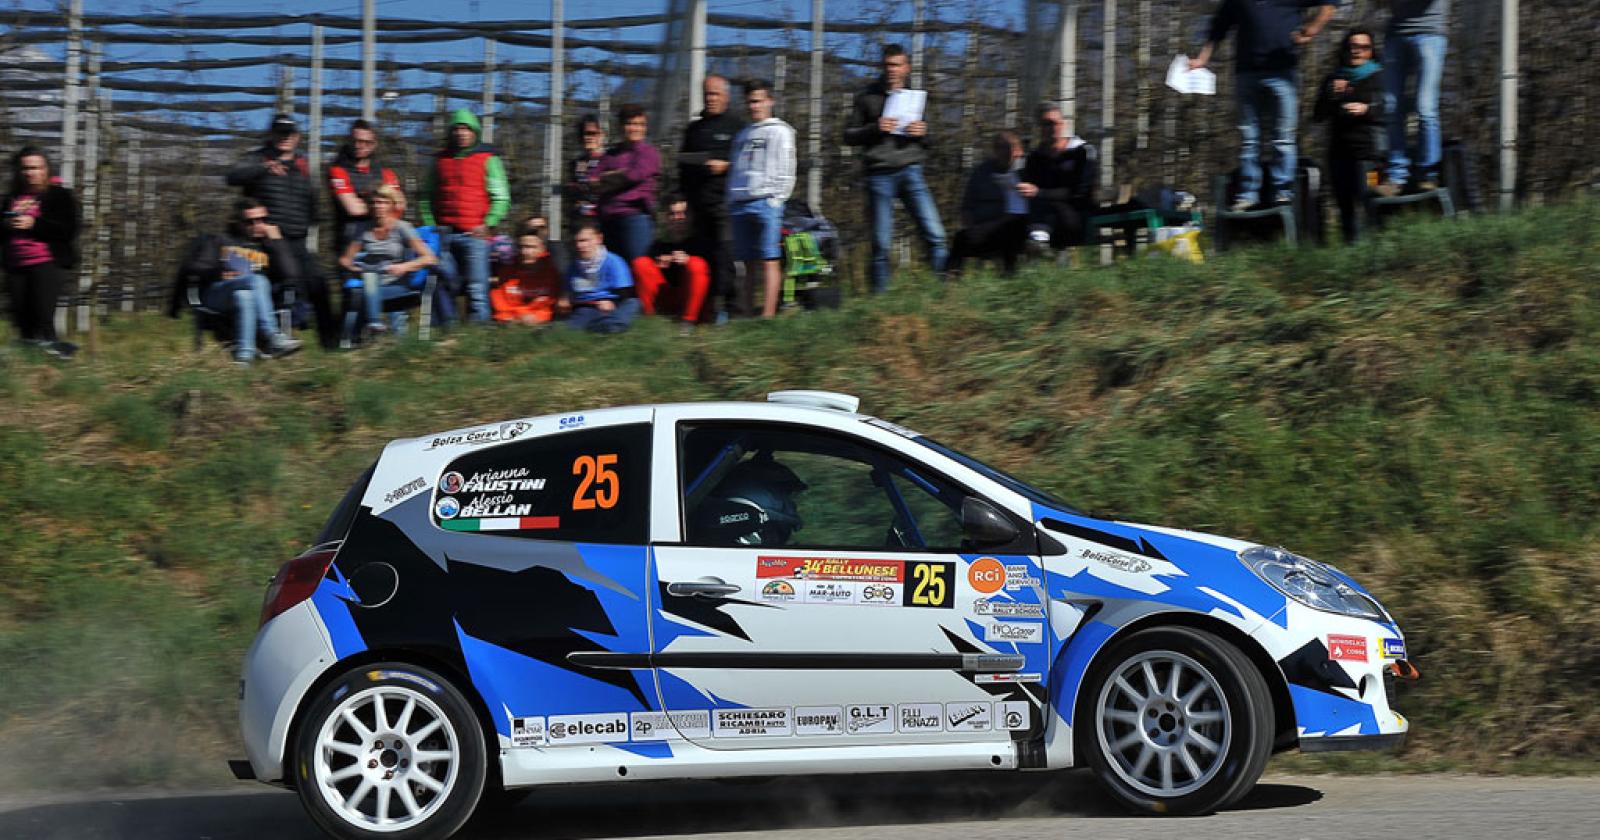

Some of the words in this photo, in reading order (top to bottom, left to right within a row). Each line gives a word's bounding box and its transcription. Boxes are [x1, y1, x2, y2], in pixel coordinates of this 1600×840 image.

[432, 437, 463, 447] Bolza
[466, 430, 498, 440] Corse
[469, 467, 530, 483] Arianna
[572, 453, 620, 510] 25
[461, 478, 546, 492] FAUSTINI
[470, 491, 513, 508] Alessio
[460, 503, 532, 517] BELLAN
[822, 564, 898, 576] BELLUNESE
[912, 563, 946, 607] 25
[809, 589, 852, 597] MAR-AUTO
[718, 711, 786, 720] SCHIESARO
[902, 717, 939, 728] PENAZZI
[568, 720, 626, 735] elecab
[635, 721, 652, 734] 2p
